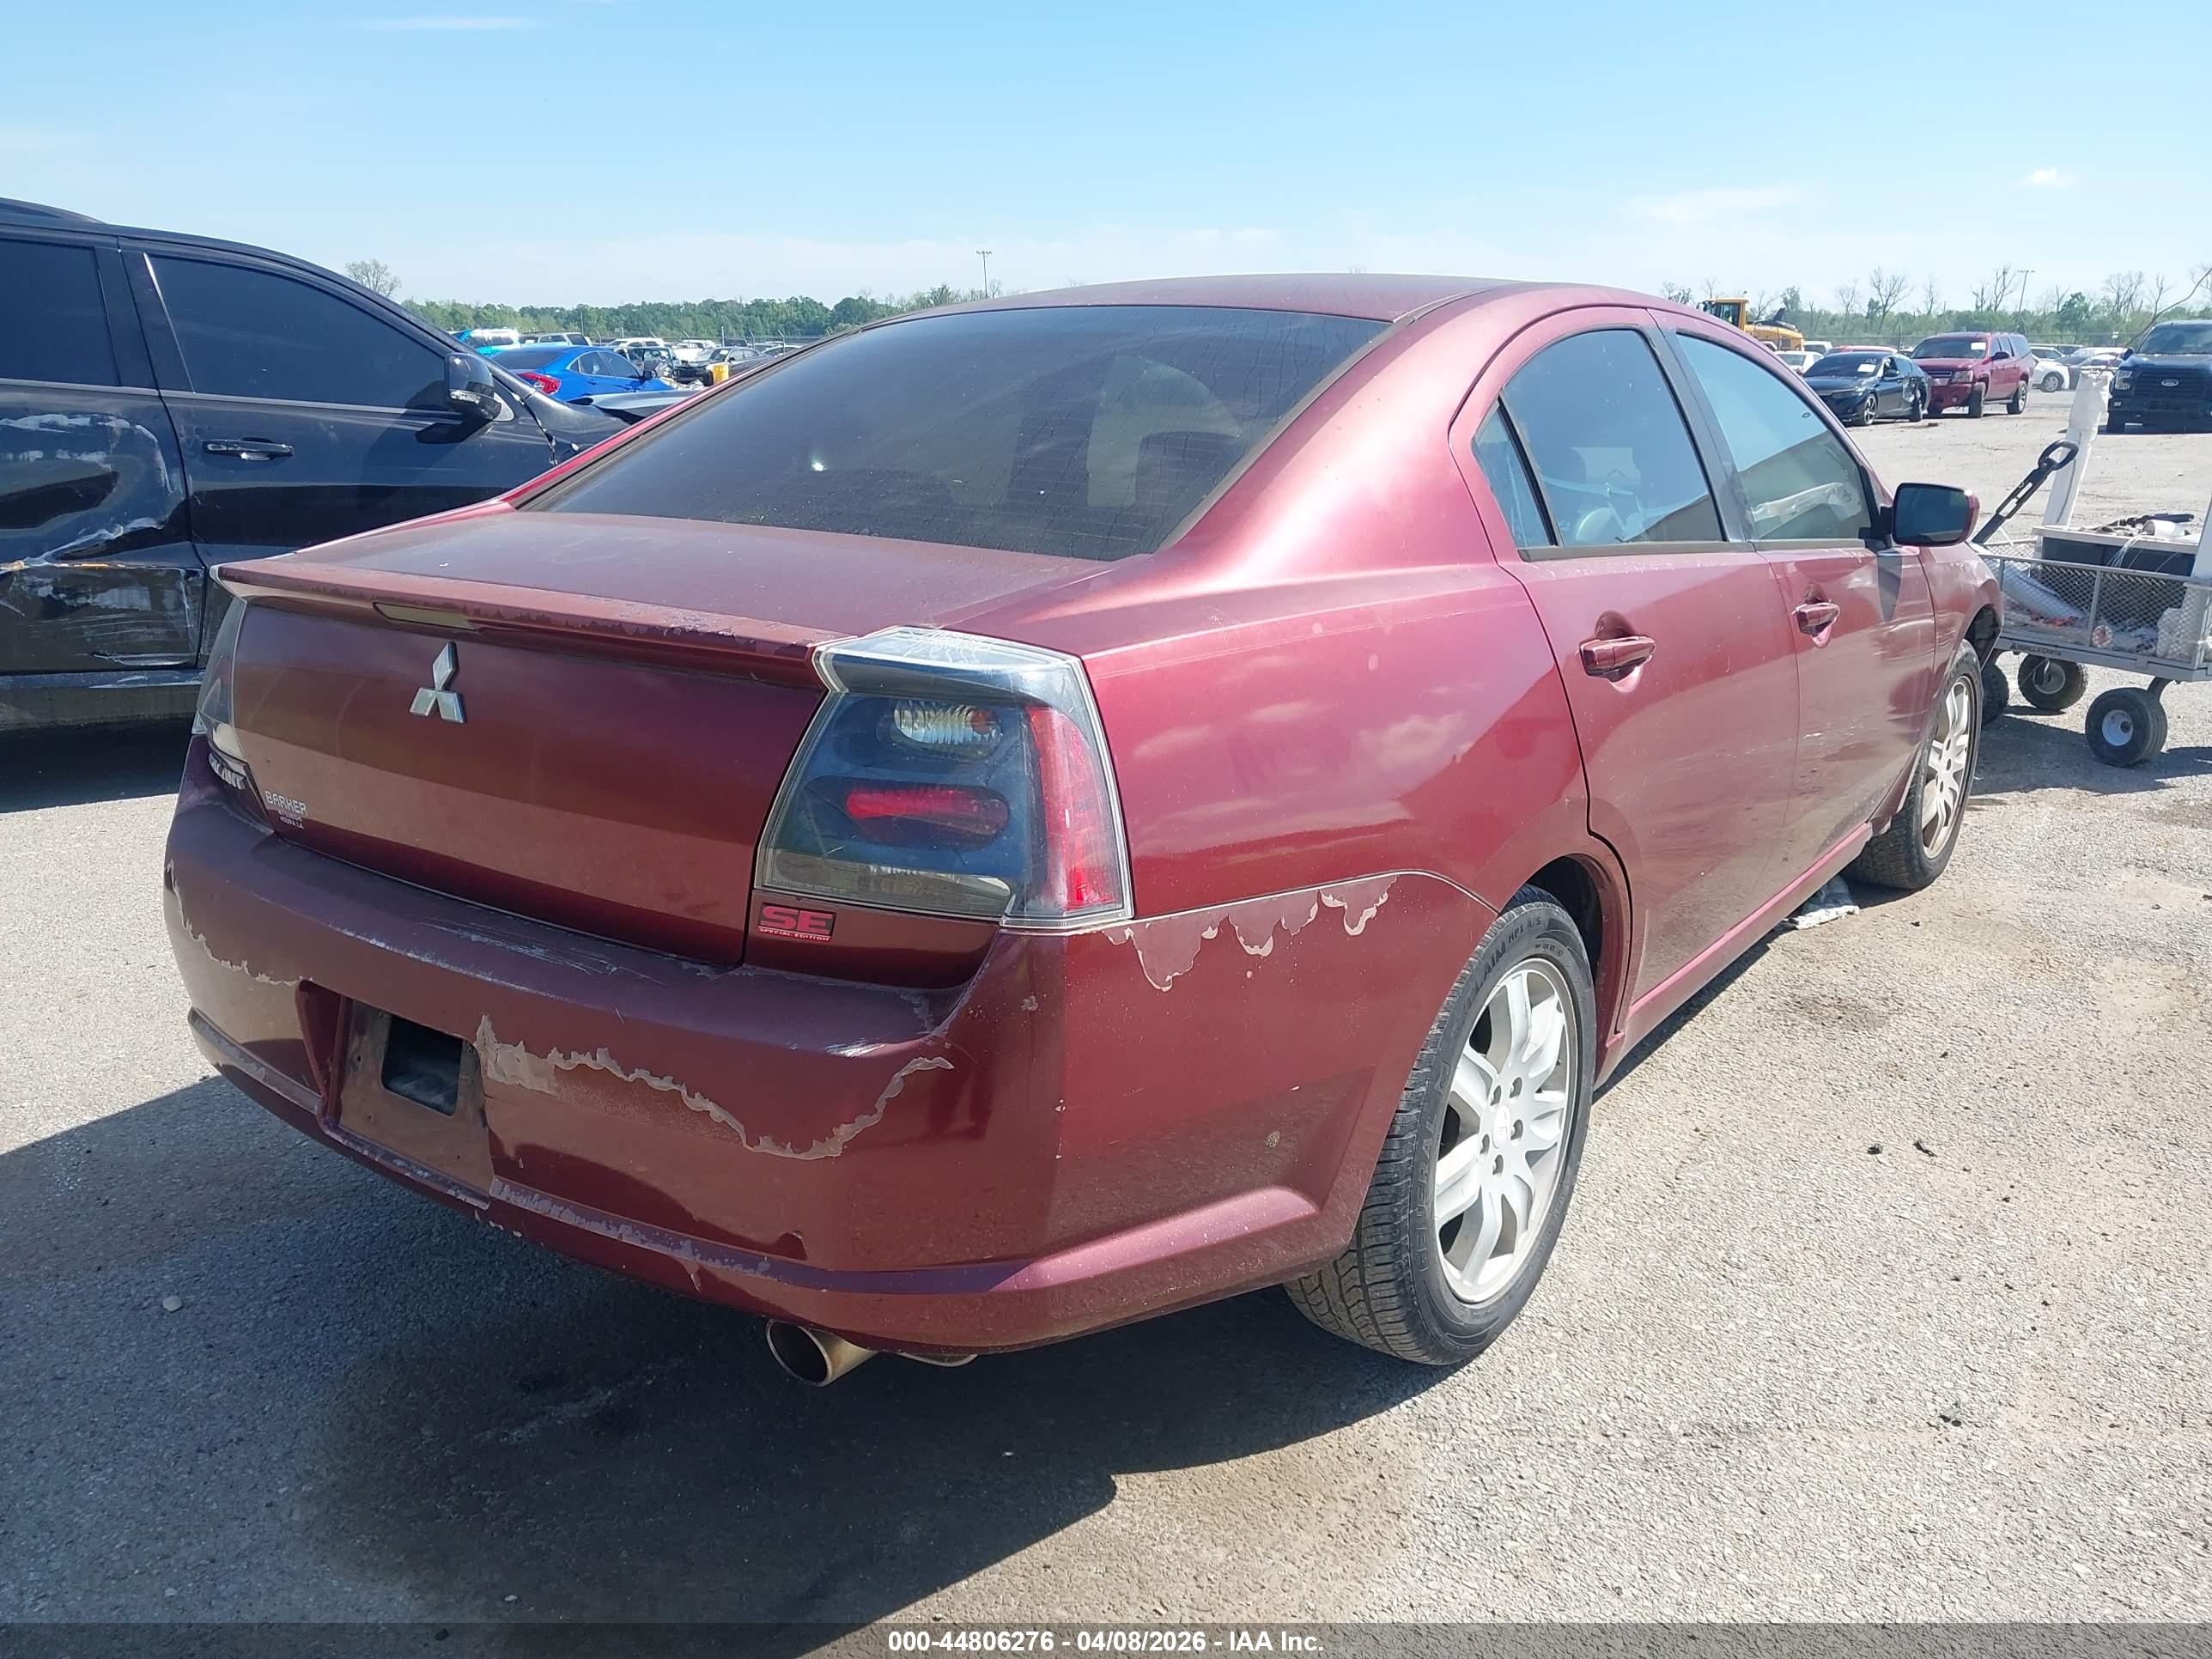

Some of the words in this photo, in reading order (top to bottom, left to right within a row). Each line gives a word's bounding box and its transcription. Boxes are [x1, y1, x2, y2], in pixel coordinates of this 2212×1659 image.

[265, 790, 308, 817] BARKER
[760, 905, 834, 936] SE
[758, 927, 792, 937] SPECIAL
[794, 933, 830, 942] EDITION
